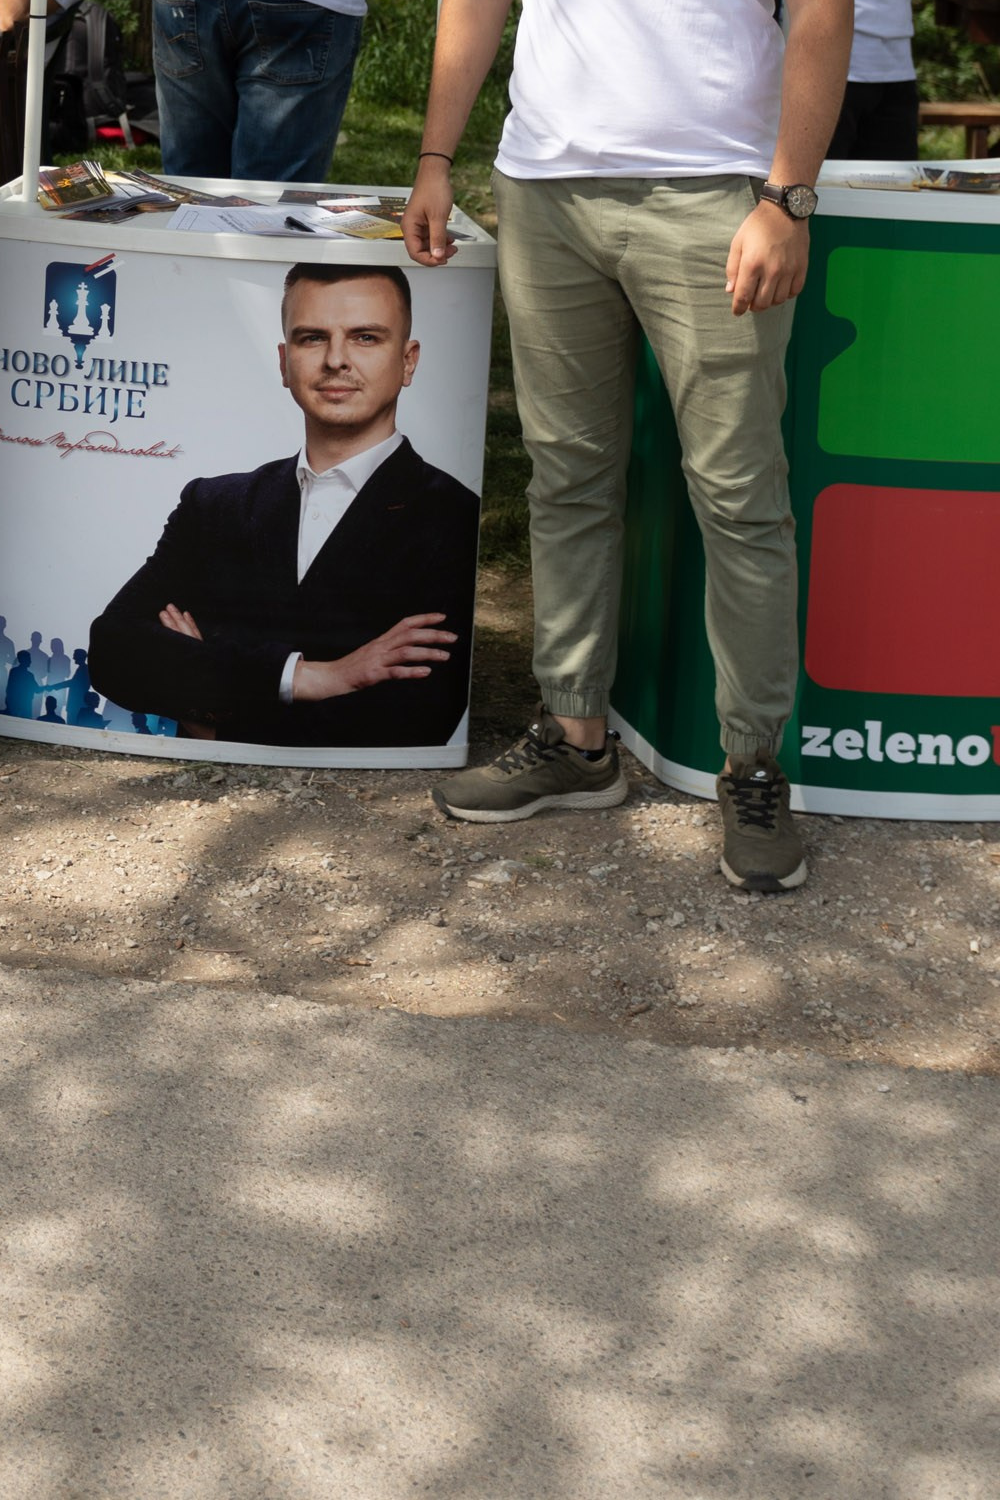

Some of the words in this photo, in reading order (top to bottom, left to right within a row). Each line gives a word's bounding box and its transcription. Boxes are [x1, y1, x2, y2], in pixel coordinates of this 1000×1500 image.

[84, 358, 170, 389] ЛИЦЕ
[10, 378, 147, 423] СРБИЈЕ
[801, 720, 1000, 767] zeleno
